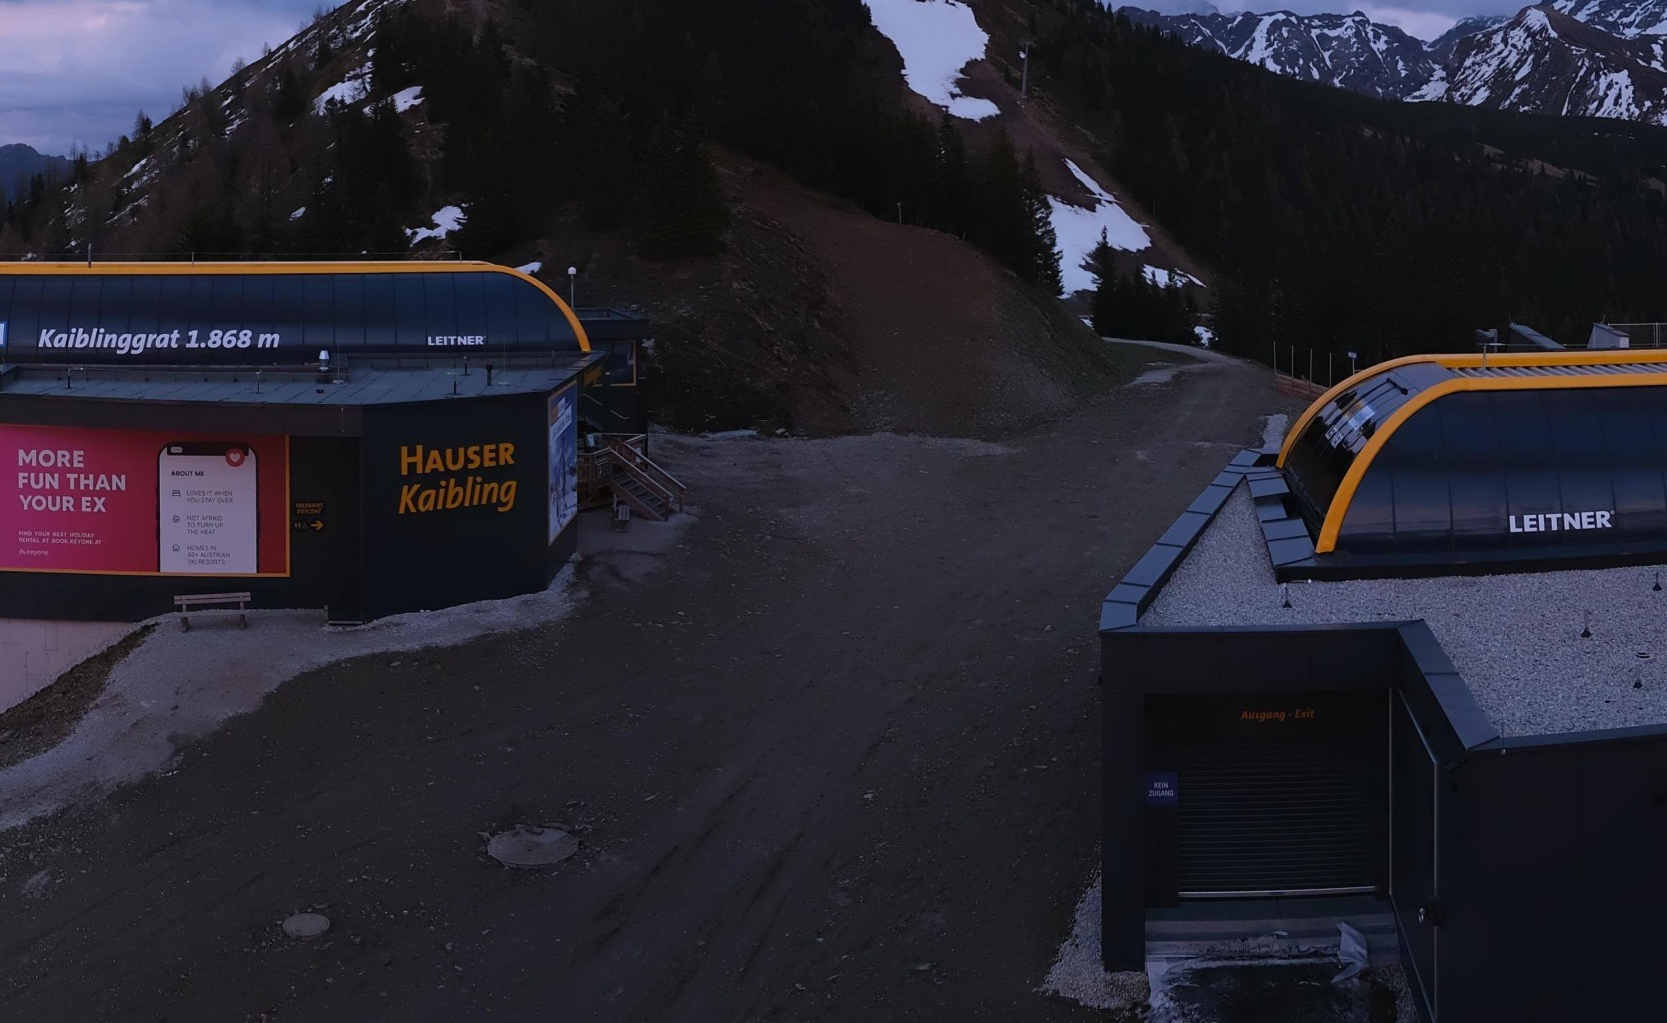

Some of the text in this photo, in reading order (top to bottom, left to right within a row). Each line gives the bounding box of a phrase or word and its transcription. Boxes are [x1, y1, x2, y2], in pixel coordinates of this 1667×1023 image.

[38, 328, 280, 355] Kaiblinggrat 1.868 m
[427, 336, 485, 346] LEITNER
[18, 449, 85, 468] MORE
[401, 442, 515, 476] HAUSER
[18, 472, 126, 491] FUN THAN
[19, 495, 107, 513] YOUR EX
[399, 476, 517, 514] Kaibling
[1509, 510, 1613, 533] LEITNER
[1240, 709, 1286, 722] Ausgang
[1294, 708, 1315, 719] Exit
[1148, 789, 1174, 797] ZUGANG
[1153, 781, 1169, 789] KEIN
